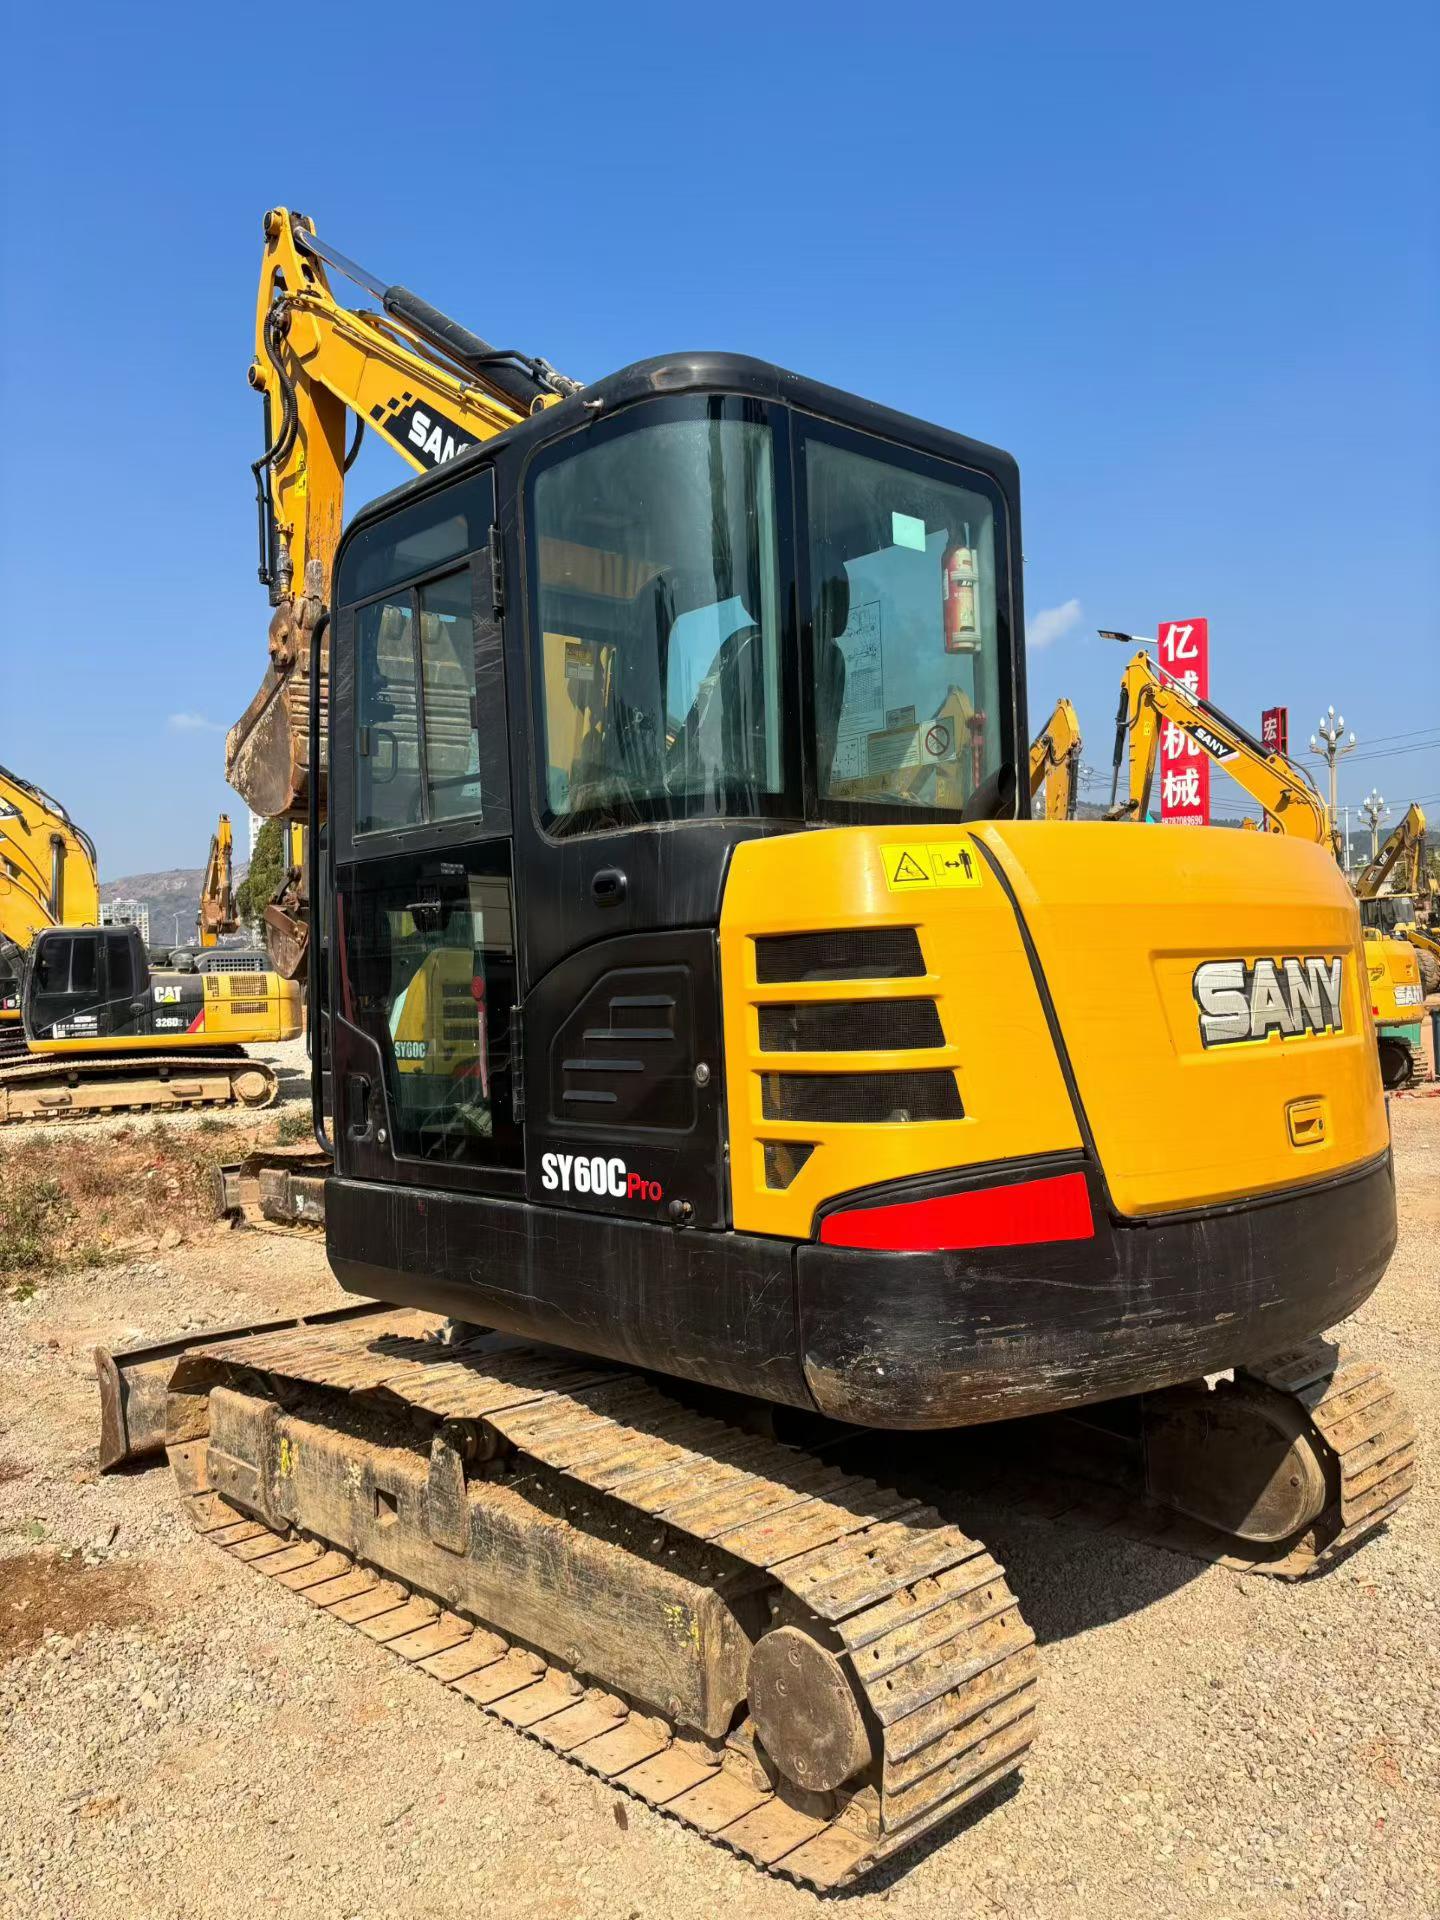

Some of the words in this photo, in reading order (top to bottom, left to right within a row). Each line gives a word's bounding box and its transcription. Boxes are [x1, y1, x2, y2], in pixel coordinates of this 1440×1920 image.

[408, 410, 474, 464] SAN
[1194, 727, 1228, 755] SANY
[1379, 851, 1389, 865] CAT
[154, 986, 182, 1003] CAT
[1192, 956, 1342, 1049] SANY
[1394, 985, 1424, 1006] SAN
[541, 1152, 627, 1198] SY60C
[627, 1172, 663, 1201] Pro
